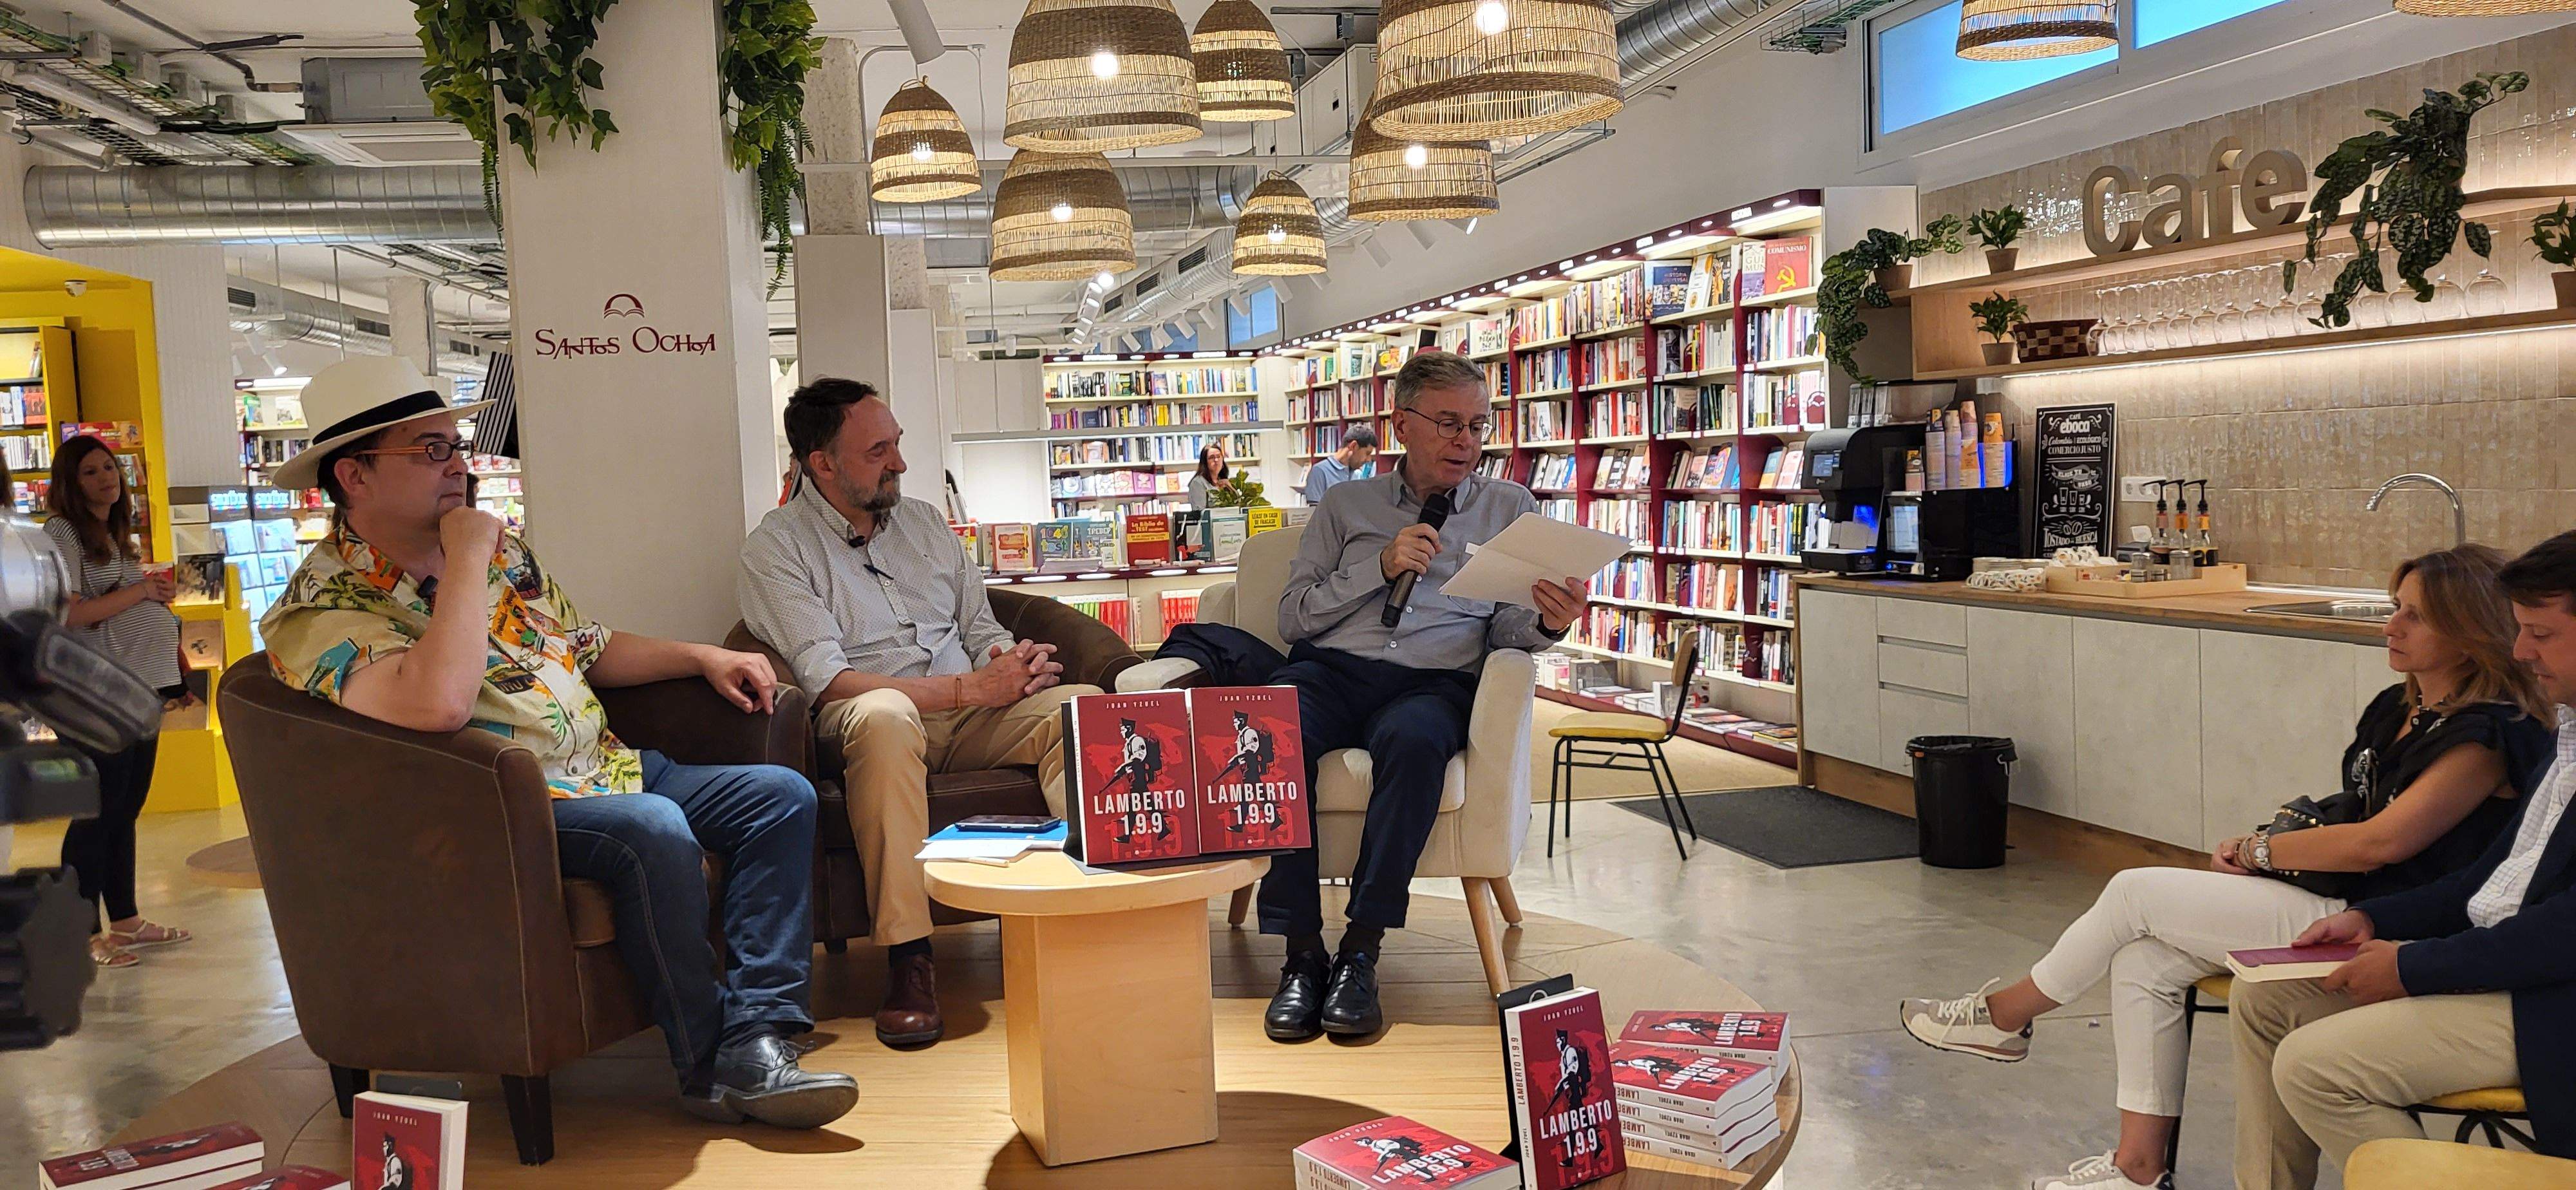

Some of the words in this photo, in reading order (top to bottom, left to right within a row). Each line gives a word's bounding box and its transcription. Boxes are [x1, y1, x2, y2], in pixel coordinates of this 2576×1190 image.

[2083, 135, 2307, 257] Cafe
[1767, 245, 1807, 254] COMUNISMO
[2060, 419, 2090, 433] eboca
[2048, 446, 2080, 455] COMERCIO
[2080, 444, 2101, 454] JUSTO
[1094, 789, 1186, 815] LAMBERTO
[1207, 781, 1297, 804] LAMBERTO
[1121, 812, 1162, 835] 1.9.9
[1233, 802, 1275, 825] 1.9.9
[1543, 1012, 1560, 1021] JUAN
[1564, 1005, 1584, 1015] YZUEL
[1714, 1013, 1743, 1044] LAMBERTO
[1511, 1037, 1521, 1057] 1.9.9
[1513, 1063, 1526, 1105] LAMBERTO
[1659, 1057, 1719, 1090] LAMBERTO
[1540, 1099, 1612, 1139] LAMBERTO
[1564, 1128, 1598, 1158] 1.9.9
[1372, 1144, 1472, 1184] LAMBERTO
[1412, 1157, 1464, 1179] 1.9.9
